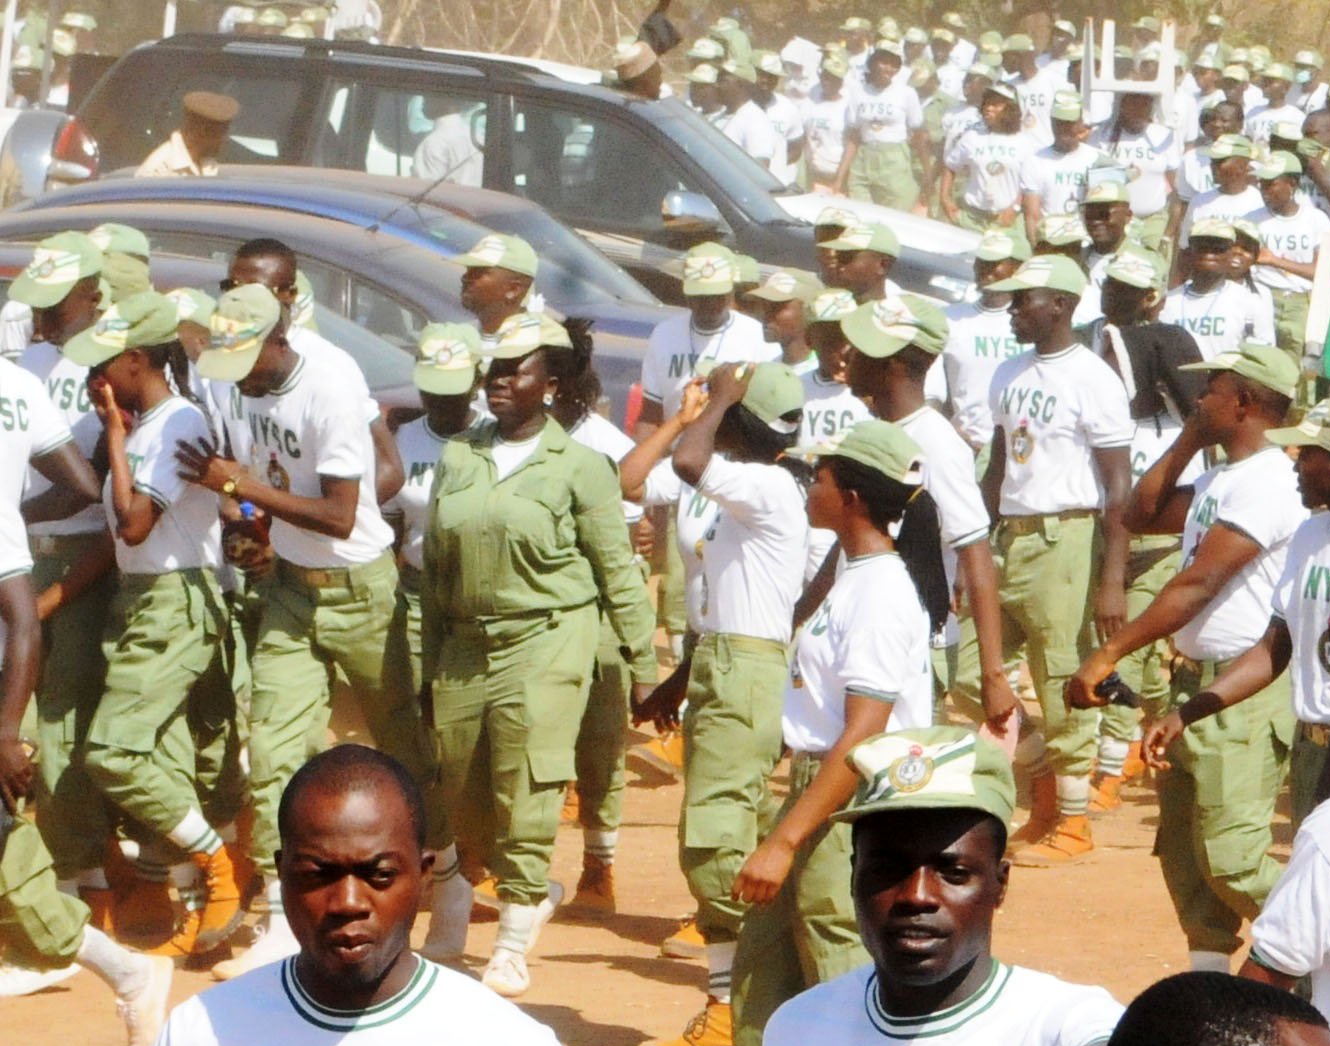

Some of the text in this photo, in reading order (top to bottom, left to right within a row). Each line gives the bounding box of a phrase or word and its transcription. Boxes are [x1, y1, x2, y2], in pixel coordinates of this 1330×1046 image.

[1022, 94, 1046, 107] YSC
[1112, 147, 1155, 161] NYSC
[1055, 171, 1086, 187] NYS
[1260, 234, 1309, 251] NYSC
[668, 353, 699, 379] NY
[50, 377, 91, 413] YSC
[1000, 387, 1057, 423] NYSC
[248, 410, 302, 459] NYSC
[802, 409, 853, 437] YSC
